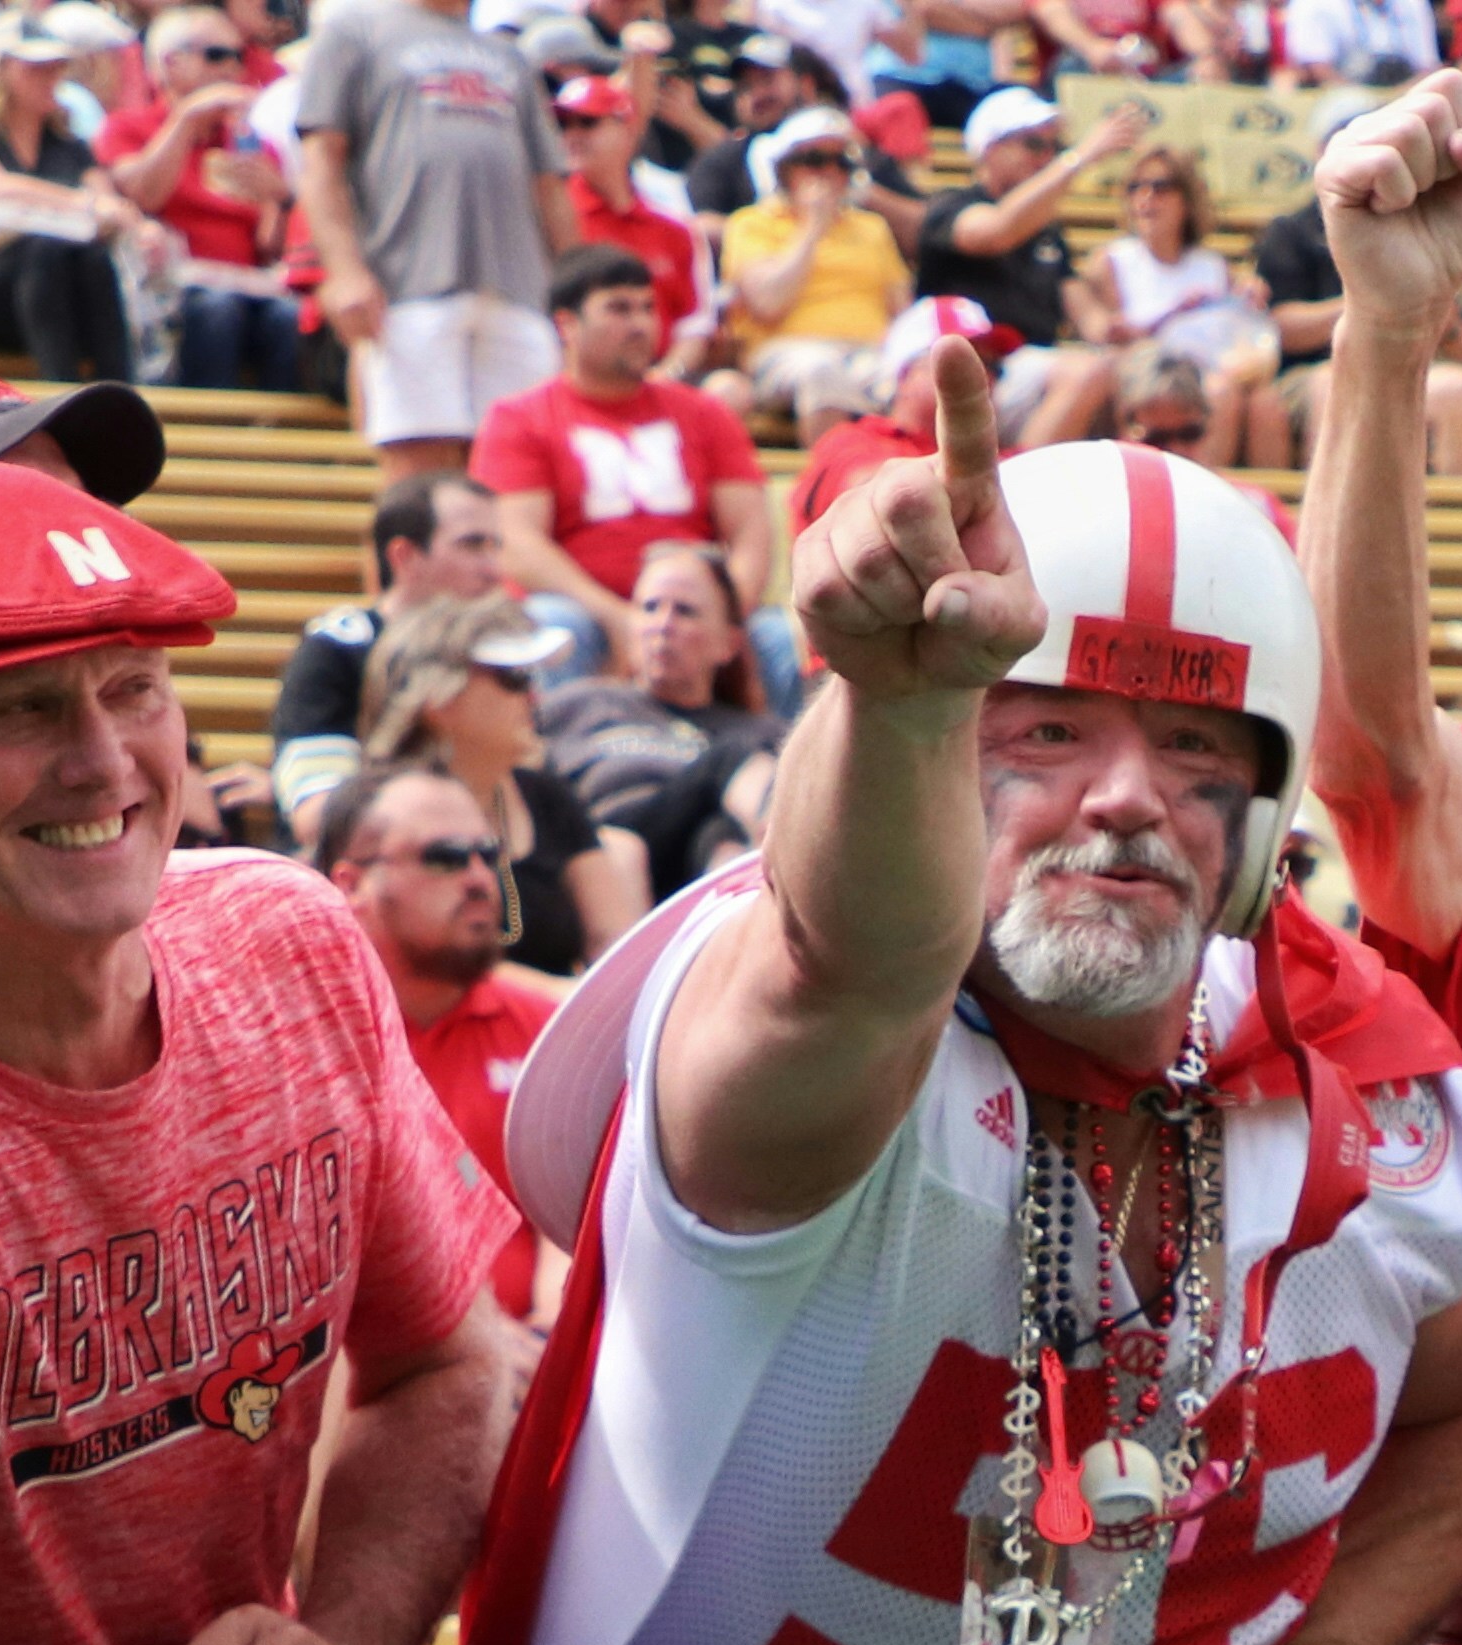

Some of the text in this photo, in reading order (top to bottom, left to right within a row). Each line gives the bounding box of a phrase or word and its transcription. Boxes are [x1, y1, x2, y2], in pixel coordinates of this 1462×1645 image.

[567, 420, 693, 521] N
[47, 527, 131, 586] N
[49, 1405, 170, 1474] HUSKERS
